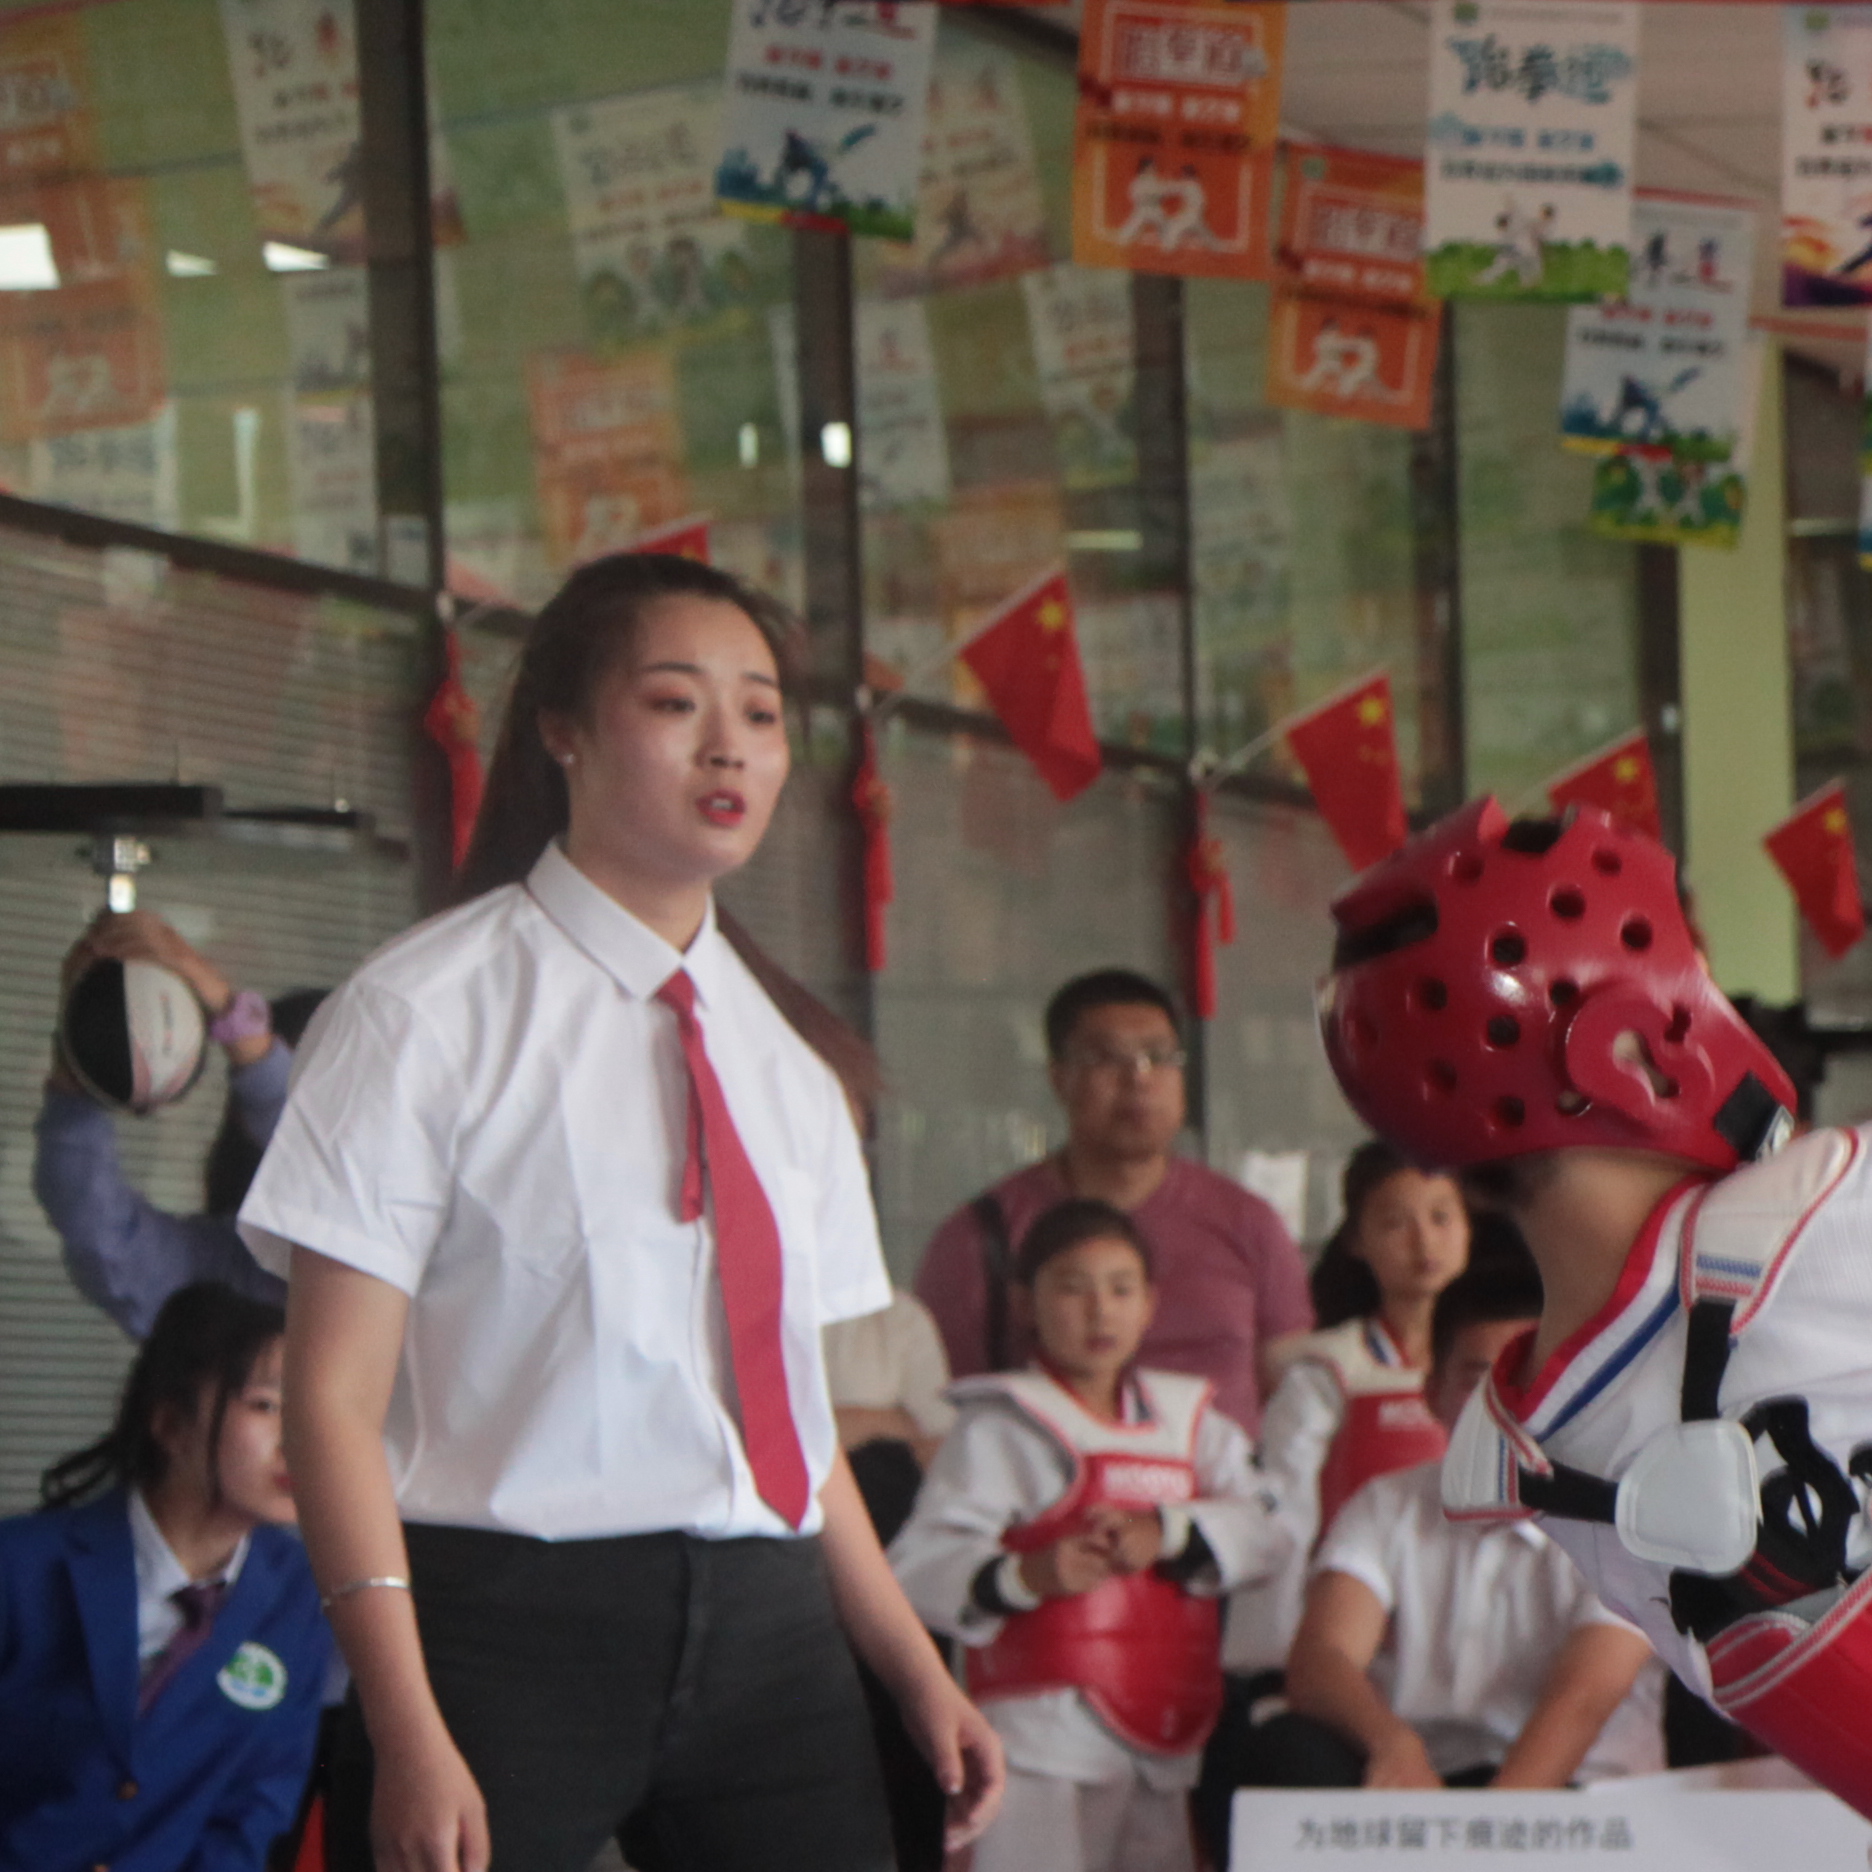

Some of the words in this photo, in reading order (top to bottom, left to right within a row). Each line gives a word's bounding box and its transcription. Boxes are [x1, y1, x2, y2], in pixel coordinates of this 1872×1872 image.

[1297, 1815, 1634, 1852] 为地球留下痕迹的作品
